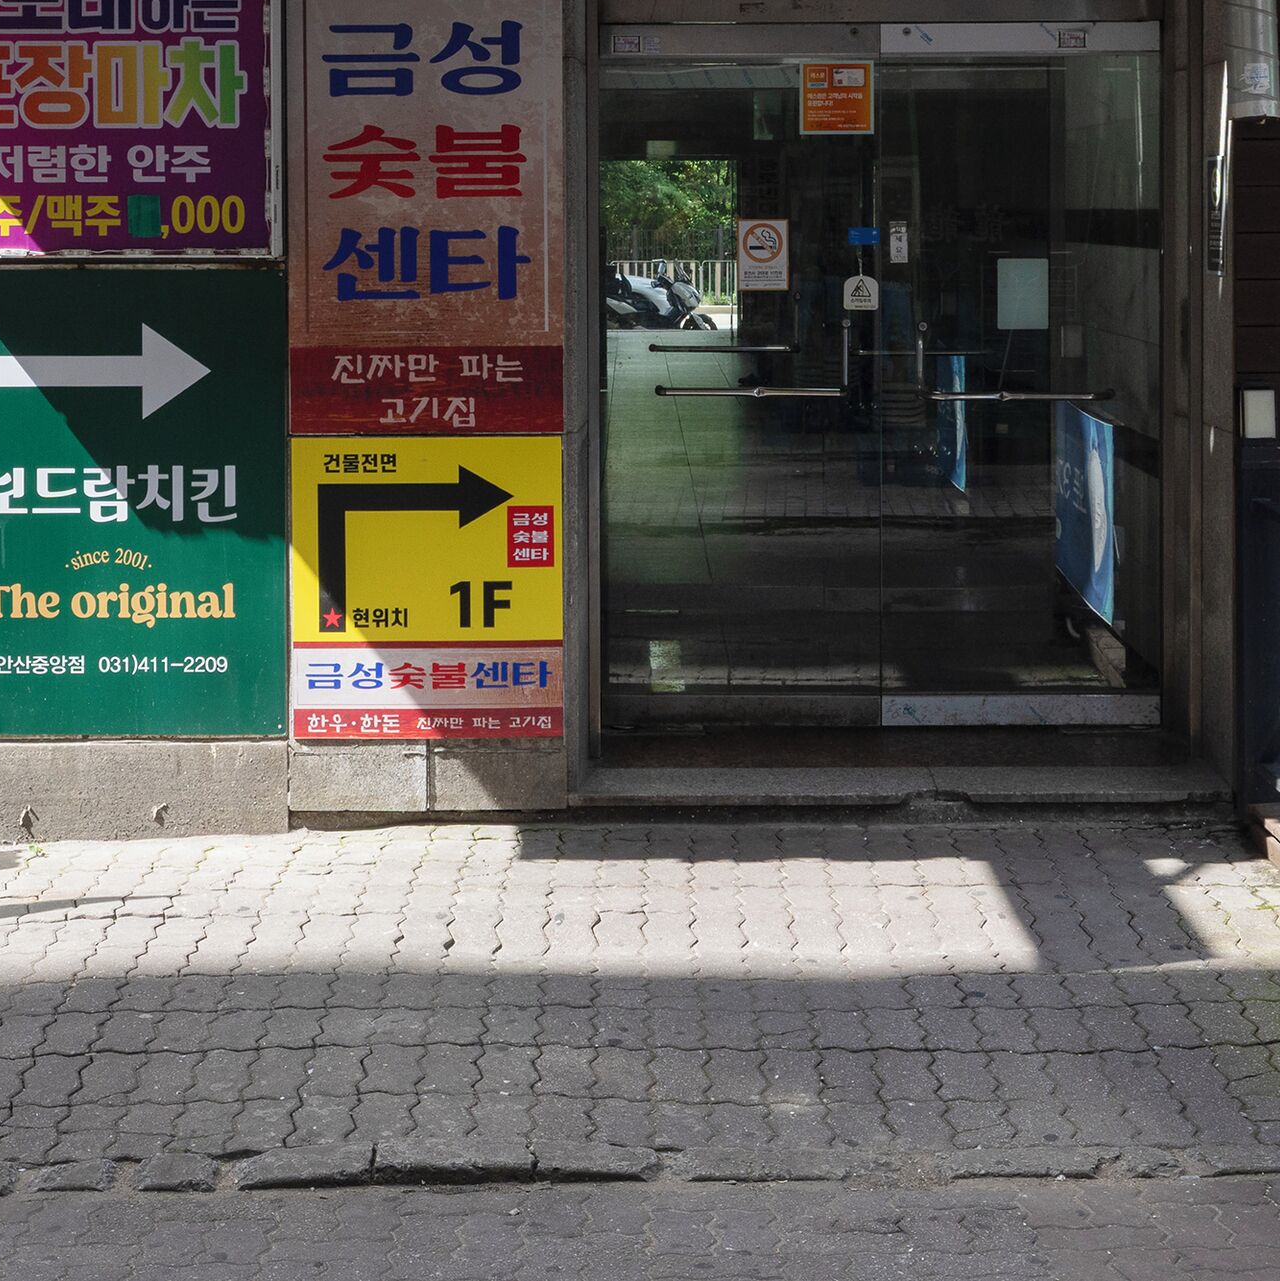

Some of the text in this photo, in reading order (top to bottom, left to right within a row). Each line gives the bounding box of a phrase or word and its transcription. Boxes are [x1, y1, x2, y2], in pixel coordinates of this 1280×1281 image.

[322, 20, 525, 98] 금성
[127, 144, 212, 184] 안주
[322, 124, 527, 199] 숯불
[128, 194, 246, 241] ,000
[322, 225, 531, 302] 센타
[331, 354, 524, 385] 진짜만 파는
[380, 396, 476, 428] 고기집
[323, 453, 397, 473] 건물전면
[513, 513, 548, 526] 금성
[512, 530, 549, 544] 숯불
[512, 548, 549, 561] 센타
[70, 582, 237, 628] original
[352, 607, 409, 628] 현위치
[449, 581, 513, 628] 1F
[98, 655, 228, 675] 031)411-2209
[305, 661, 553, 690] 금성숯불센타
[416, 717, 464, 730] 진짜만
[472, 717, 501, 730] 파는
[509, 715, 552, 730] 고기집
